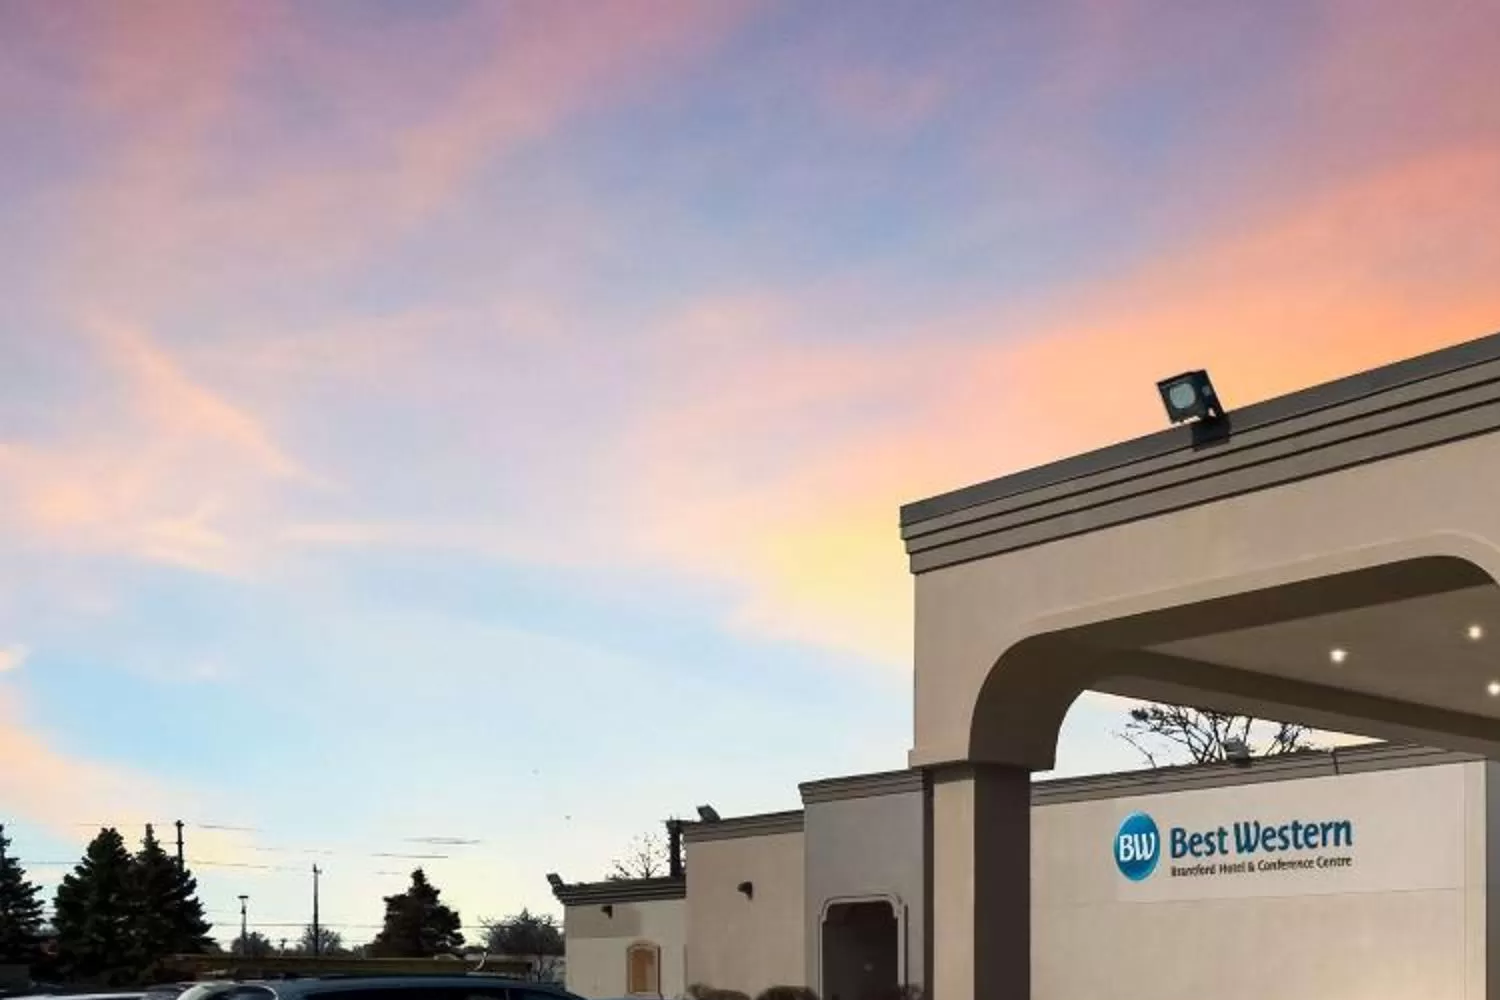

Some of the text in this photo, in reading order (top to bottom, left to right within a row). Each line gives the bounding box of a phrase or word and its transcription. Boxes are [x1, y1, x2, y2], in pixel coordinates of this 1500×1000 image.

[1119, 834, 1155, 861] BW
[1170, 819, 1352, 859] Best Western
[1219, 862, 1246, 874] Hotel
[1248, 862, 1255, 873] &
[1258, 858, 1315, 872] Conference
[1316, 856, 1353, 868] Centre
